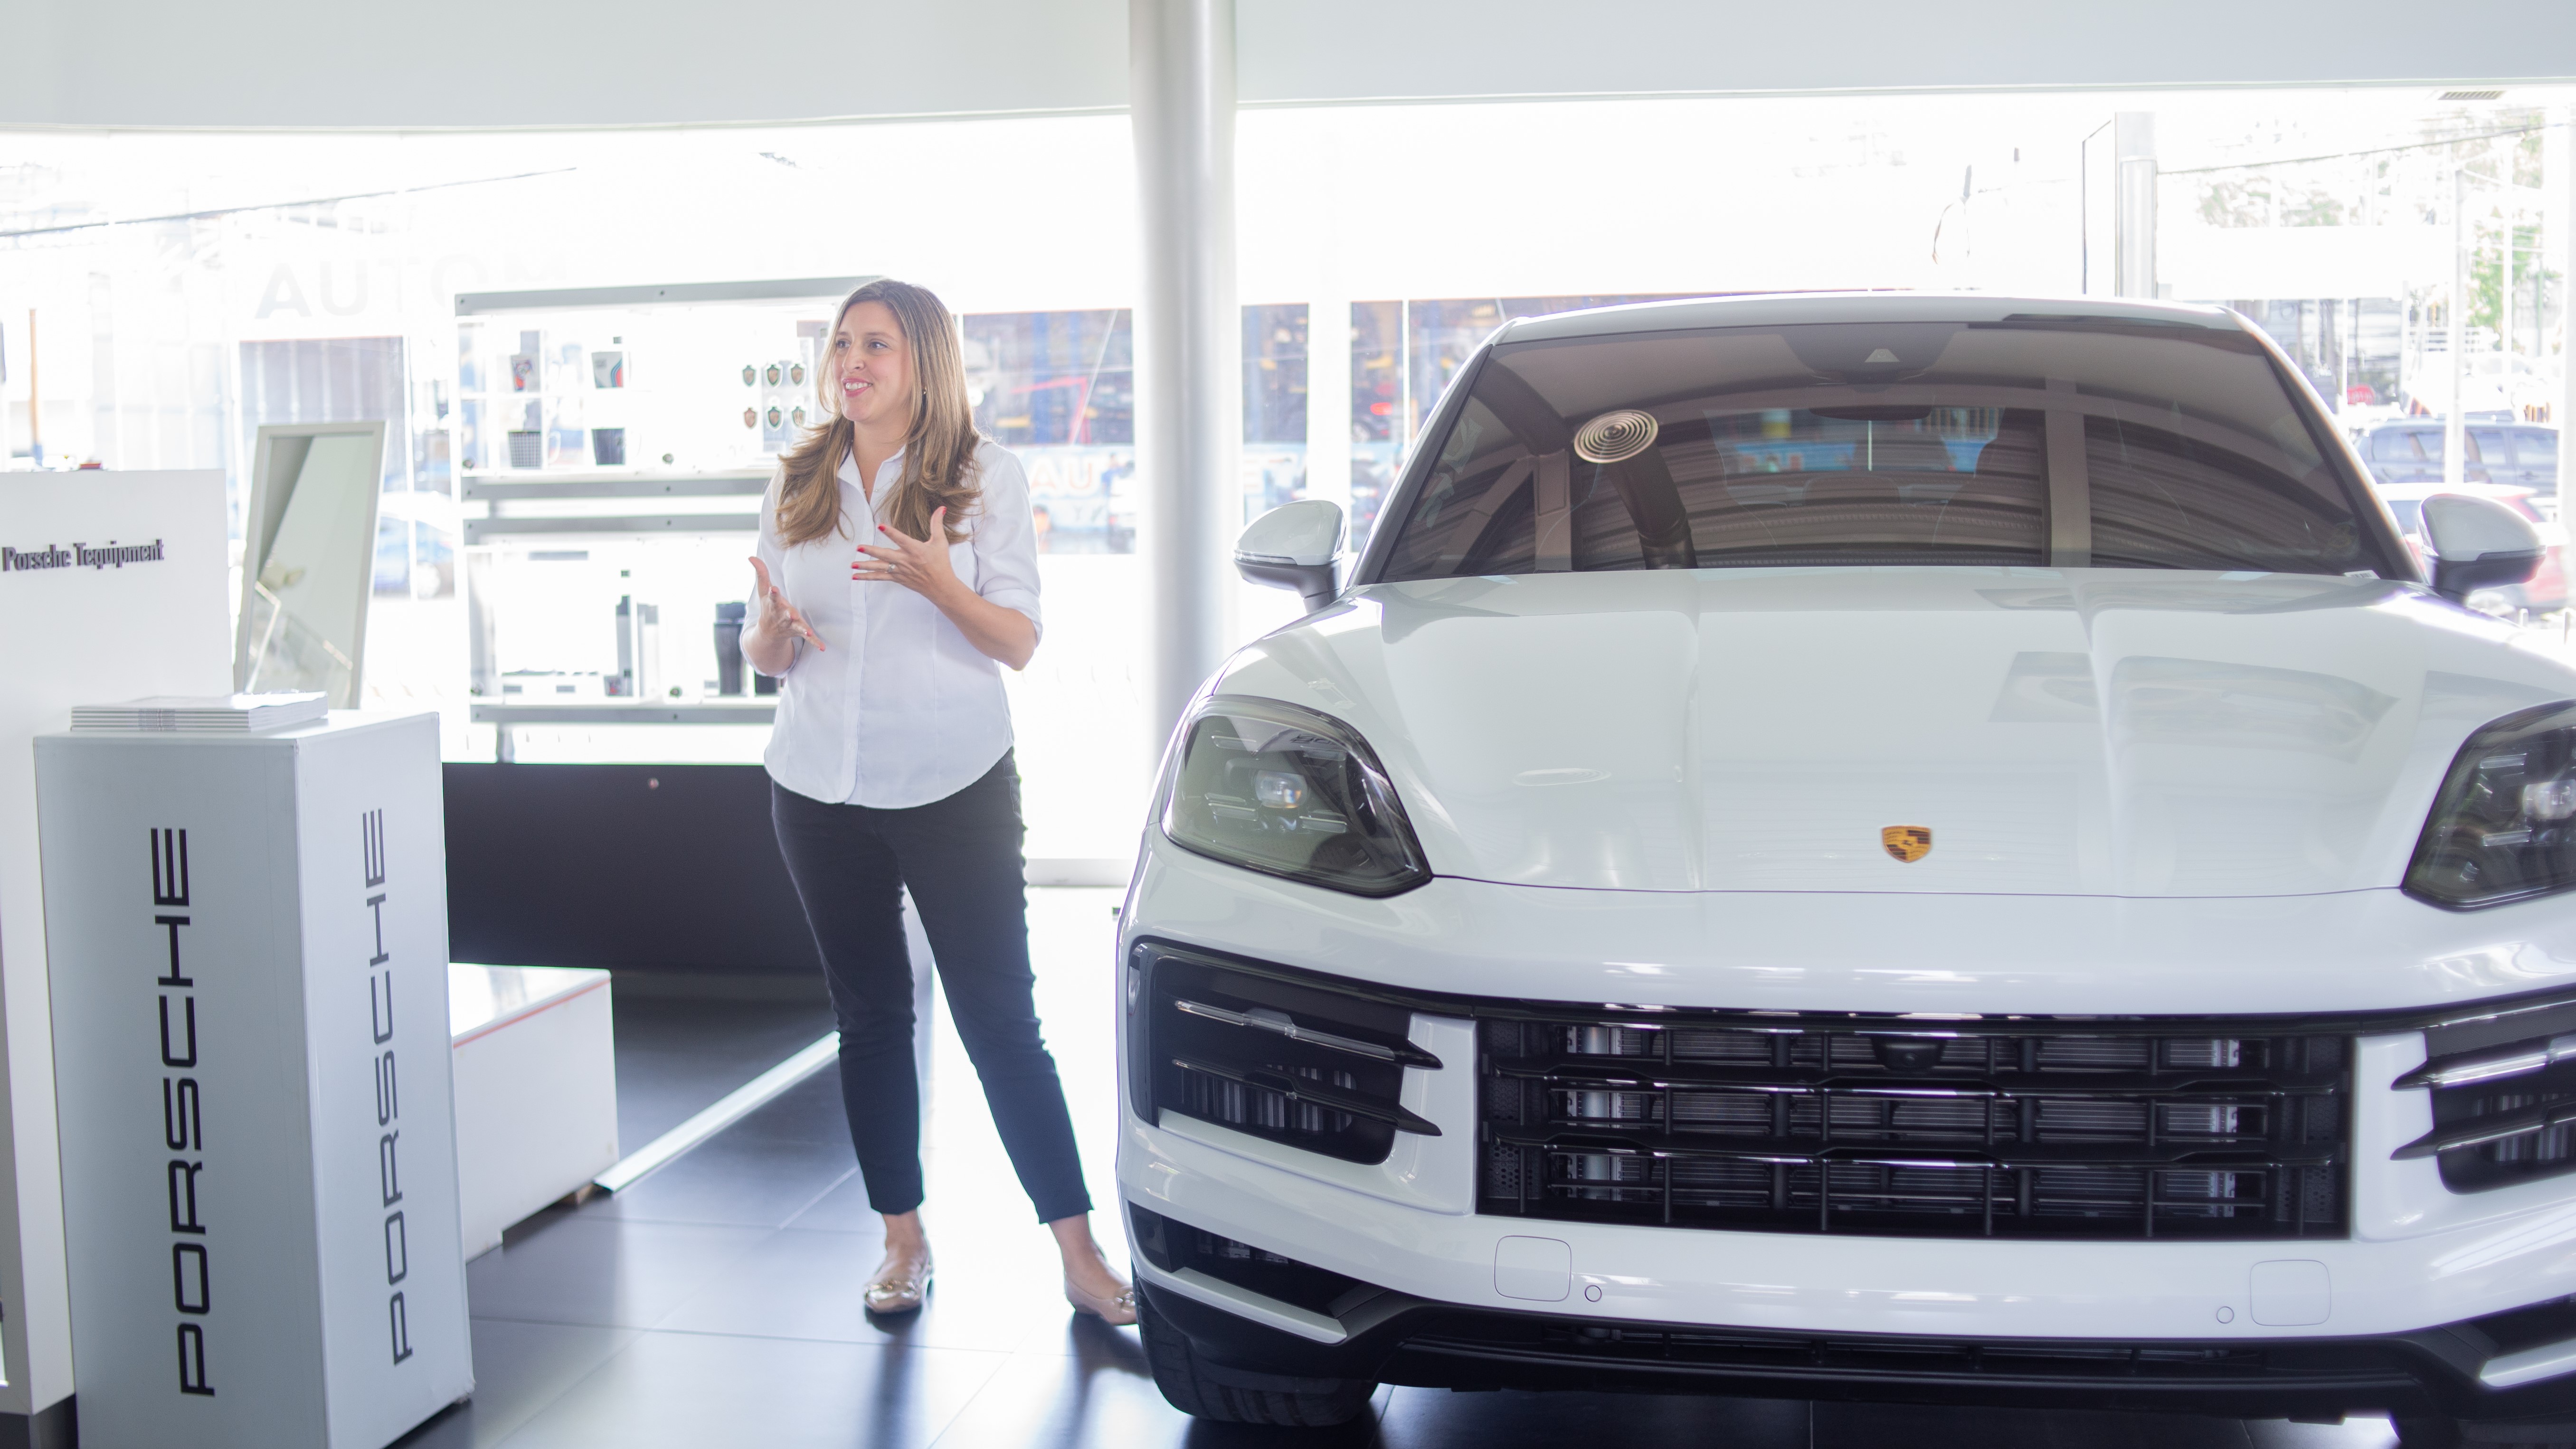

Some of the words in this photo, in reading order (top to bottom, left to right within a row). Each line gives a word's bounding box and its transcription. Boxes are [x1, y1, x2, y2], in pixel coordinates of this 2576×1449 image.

[2, 544, 71, 571] Porsche
[73, 538, 164, 569] Tequipment
[151, 828, 215, 1396] PORSCHE
[362, 808, 413, 1366] PORSCHE
